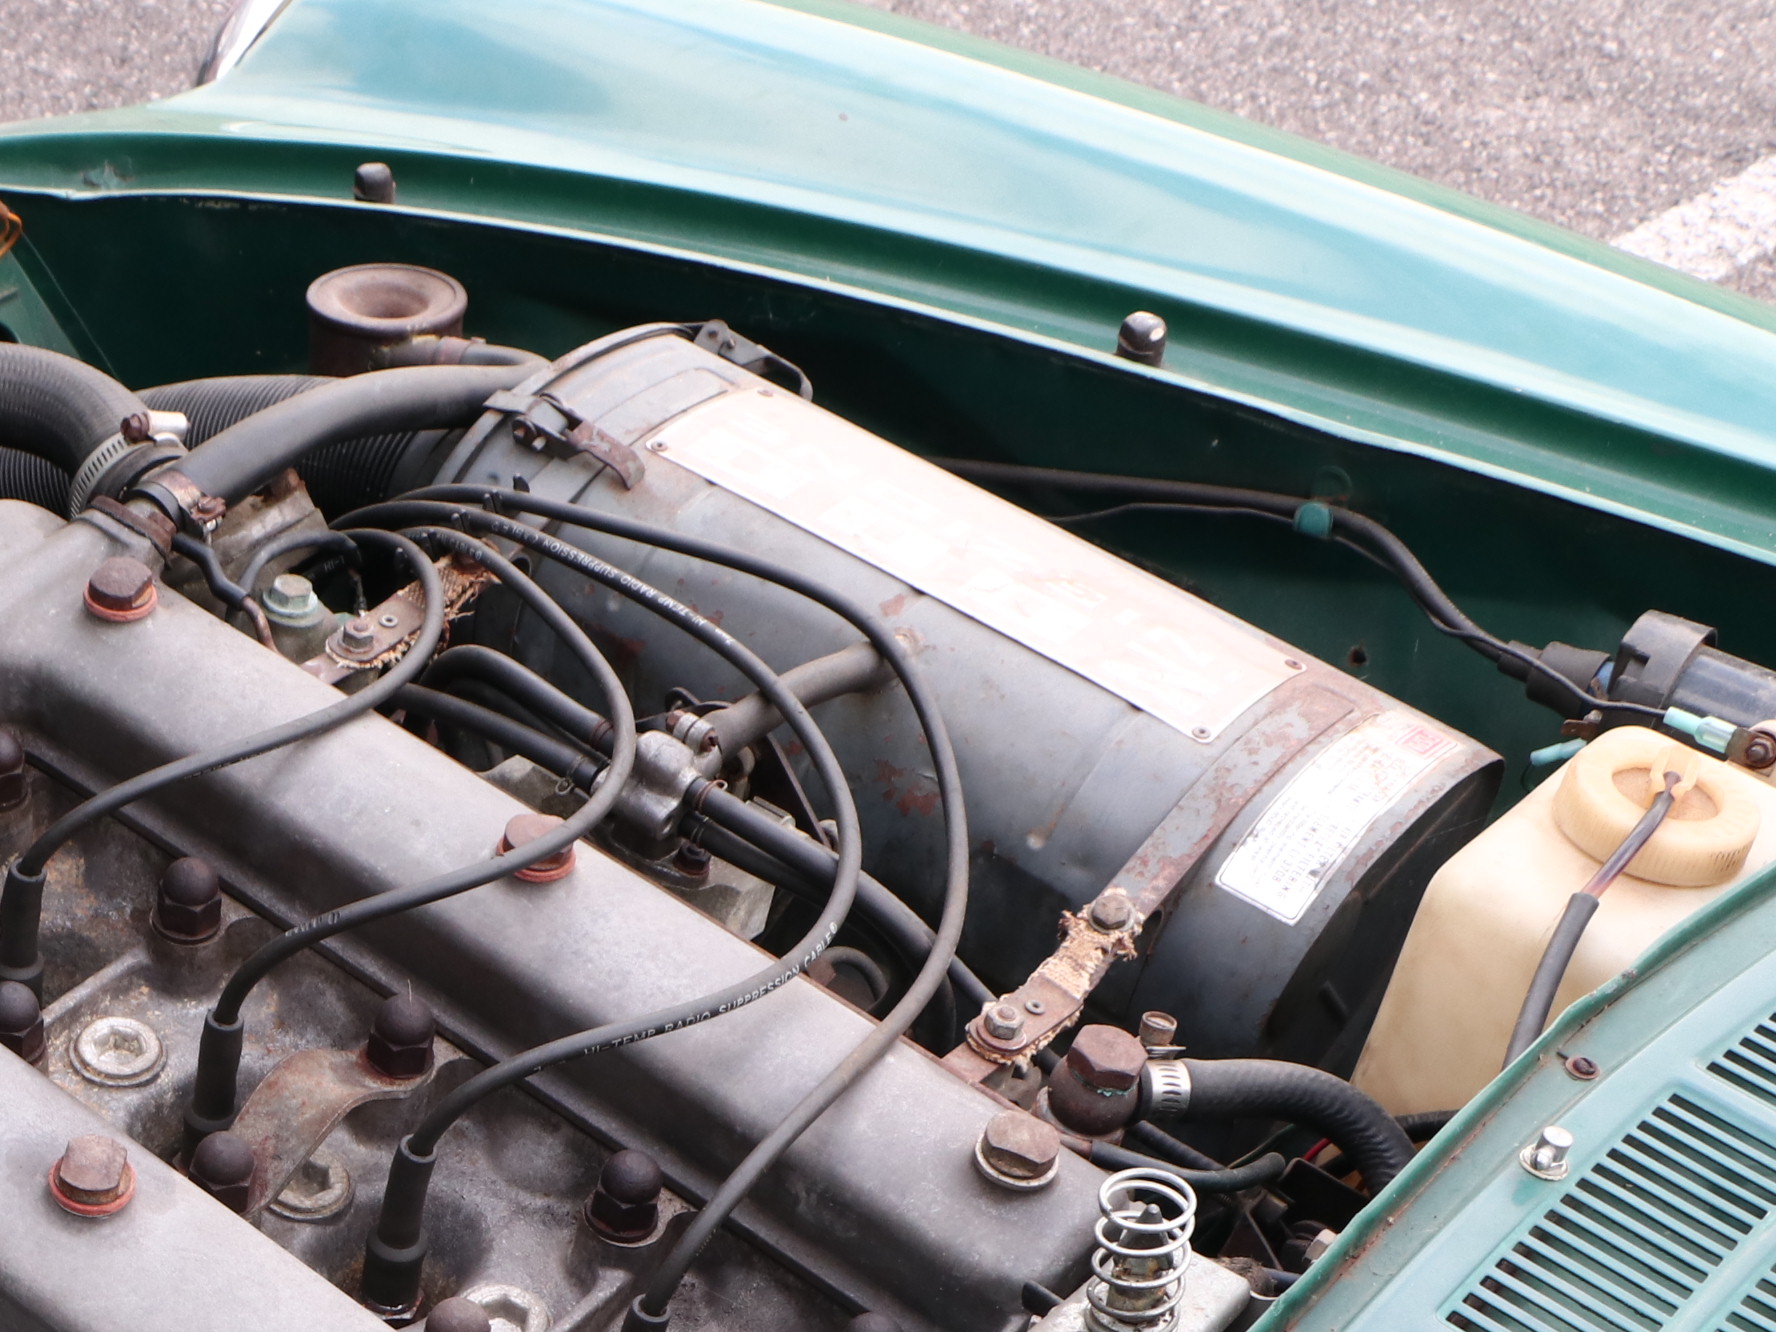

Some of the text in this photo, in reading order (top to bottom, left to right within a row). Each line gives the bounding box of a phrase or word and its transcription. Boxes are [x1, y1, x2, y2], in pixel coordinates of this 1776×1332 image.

[540, 537, 618, 577] SUPPRESSION
[619, 573, 657, 596] RADIO
[656, 593, 708, 626] HI-TEMP
[719, 963, 801, 1014] SUPPRESSION
